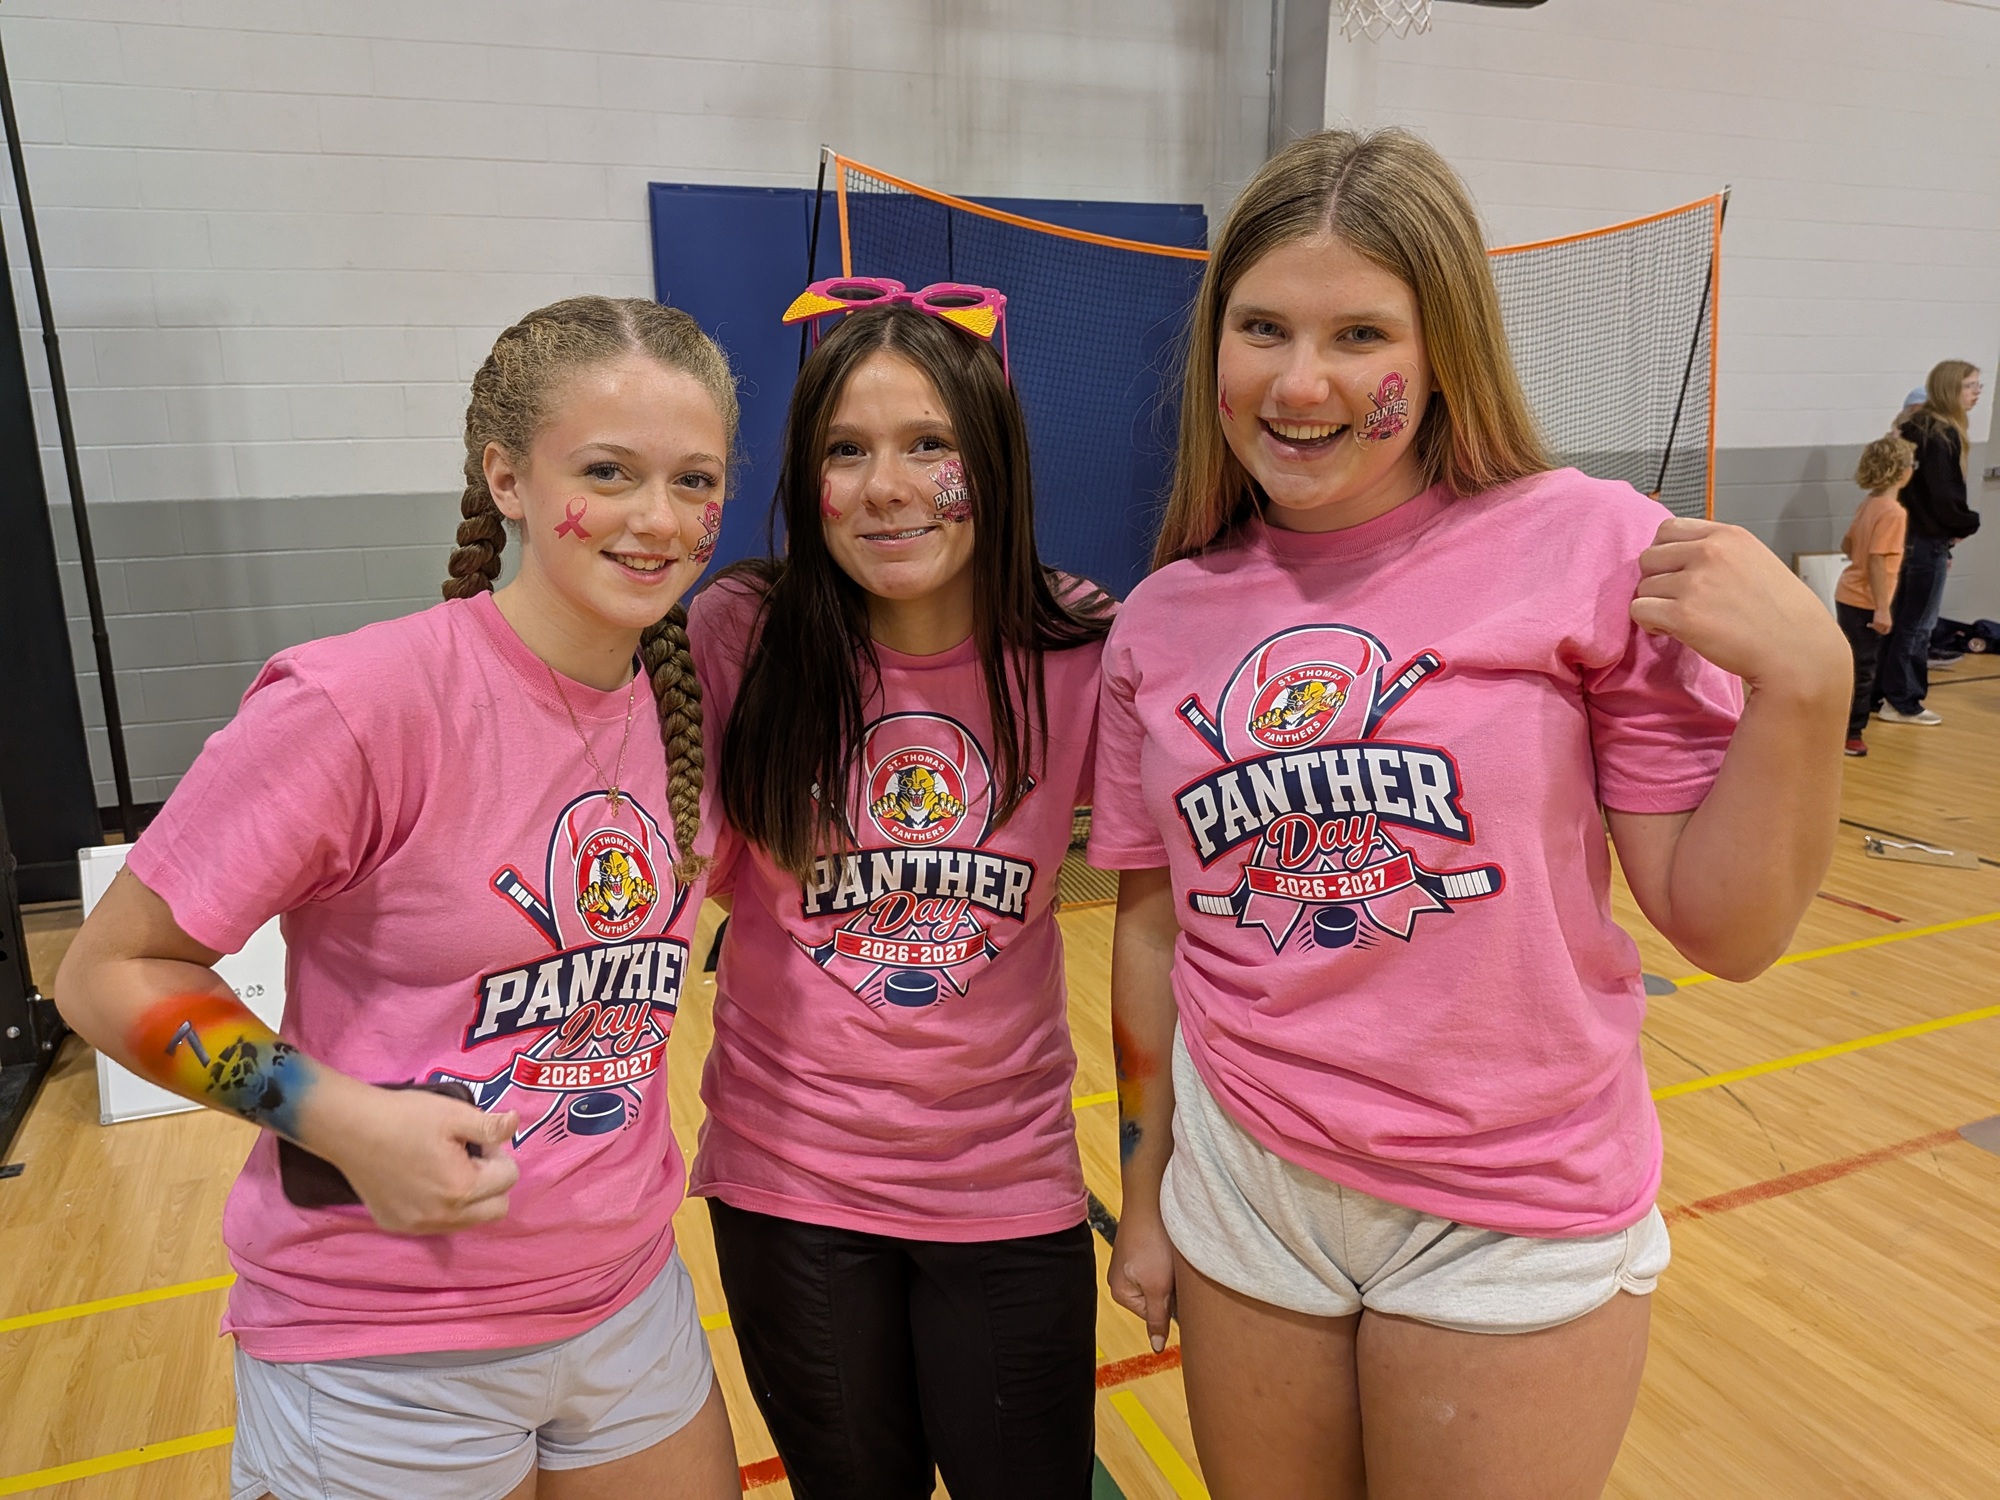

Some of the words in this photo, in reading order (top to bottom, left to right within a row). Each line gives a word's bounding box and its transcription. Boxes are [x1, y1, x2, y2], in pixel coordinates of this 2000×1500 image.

[1365, 399, 1408, 427] PANTHER
[934, 488, 969, 509] PANTH
[1278, 675, 1295, 688] ST.
[1298, 669, 1343, 682] THOMAS
[1263, 720, 1321, 743] PANTHERS
[887, 759, 902, 772] ST.
[903, 754, 945, 771] THOMAS
[1180, 748, 1463, 859] PANTHER
[891, 825, 945, 841] PANTHERS
[1267, 813, 1382, 868] Day
[587, 842, 600, 857] ST.
[599, 837, 635, 854] THOMAS
[805, 850, 1032, 914] PANTHER
[1275, 868, 1386, 898] 2026-2027
[594, 914, 640, 934] PANTHERS
[869, 891, 969, 941] Day
[860, 940, 968, 963] 2026-2027
[554, 1000, 650, 1057] Day
[537, 1052, 652, 1086] 2026-2027
